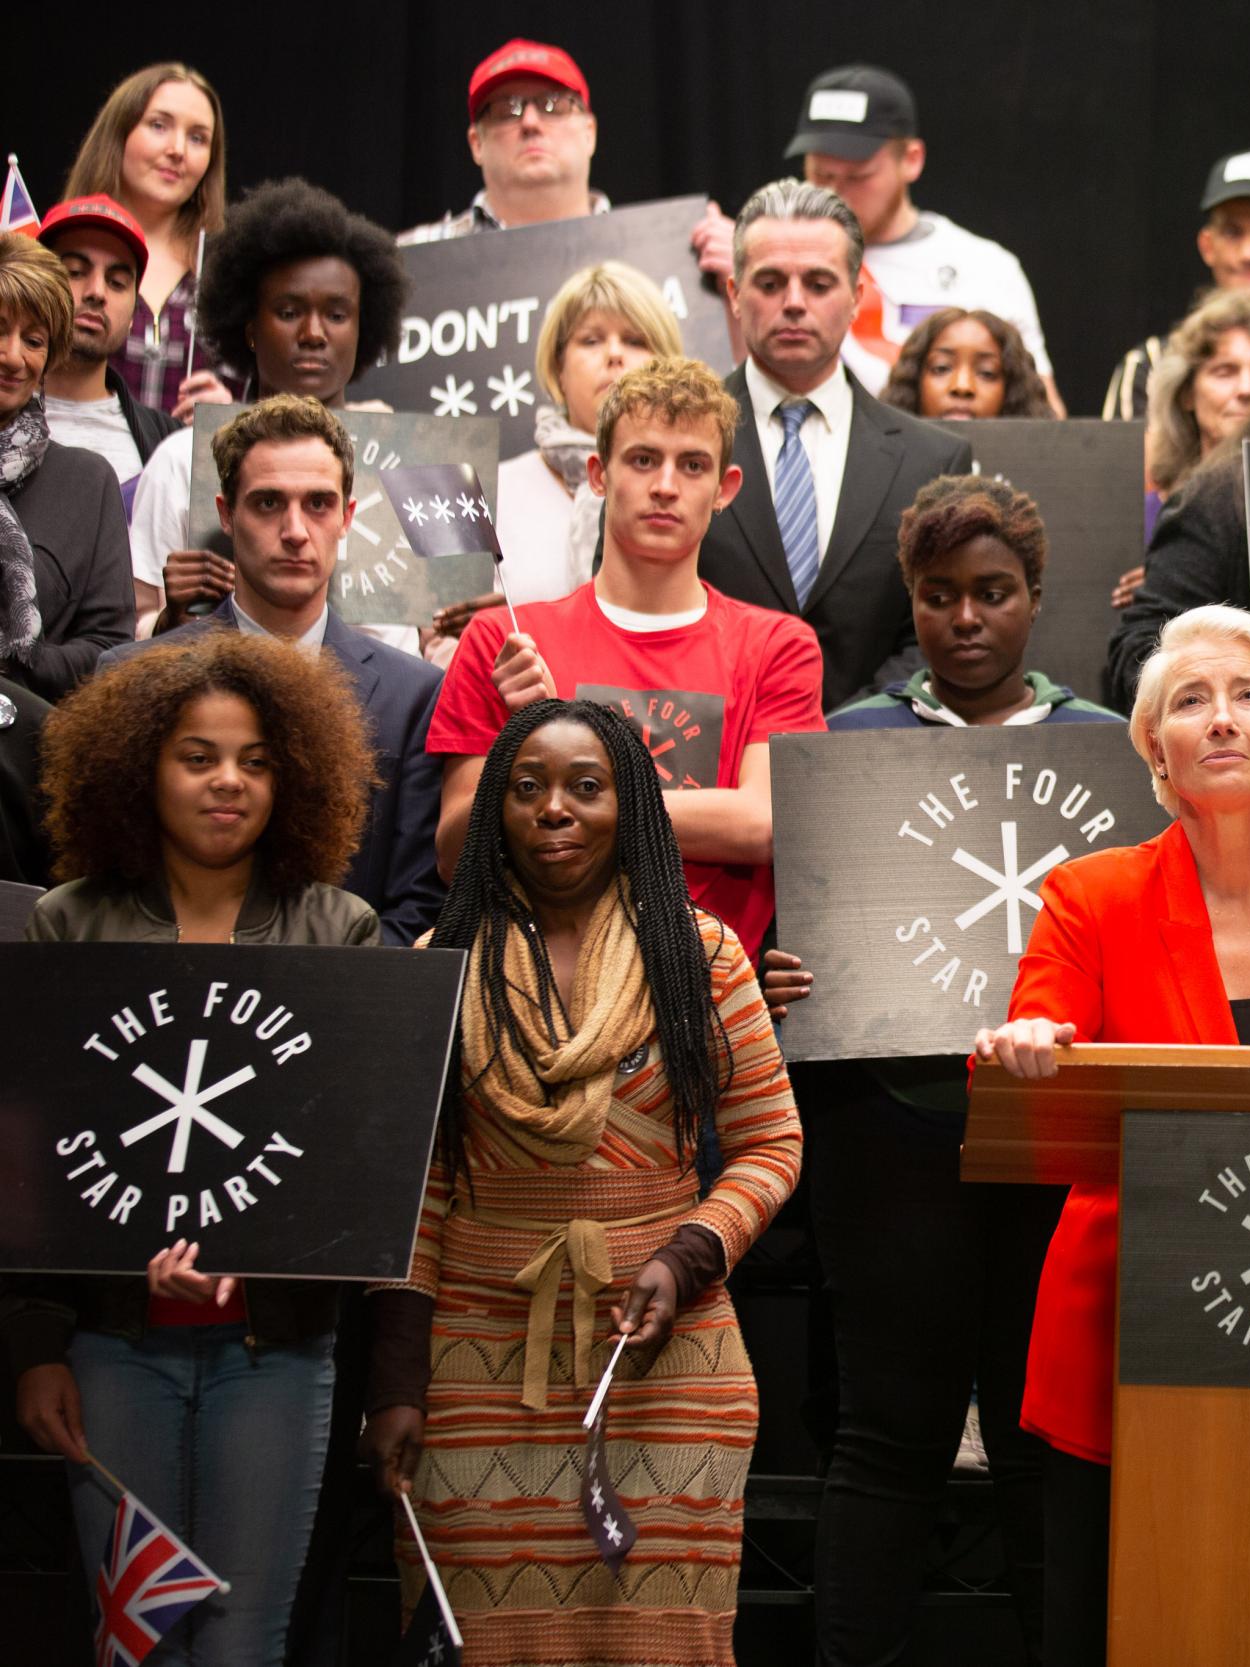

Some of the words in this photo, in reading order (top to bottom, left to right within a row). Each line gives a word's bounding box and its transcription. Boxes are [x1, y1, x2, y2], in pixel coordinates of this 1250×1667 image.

[398, 297, 539, 364] DON'T
[662, 276, 689, 319] A
[648, 698, 701, 742] FOUR
[897, 773, 979, 847] THE
[1006, 763, 1116, 844] FOUR
[896, 916, 989, 1007] STAR
[83, 989, 174, 1061] THE
[203, 981, 312, 1065] FOUR
[56, 1130, 143, 1225] STAR
[166, 1131, 304, 1232] PARTY
